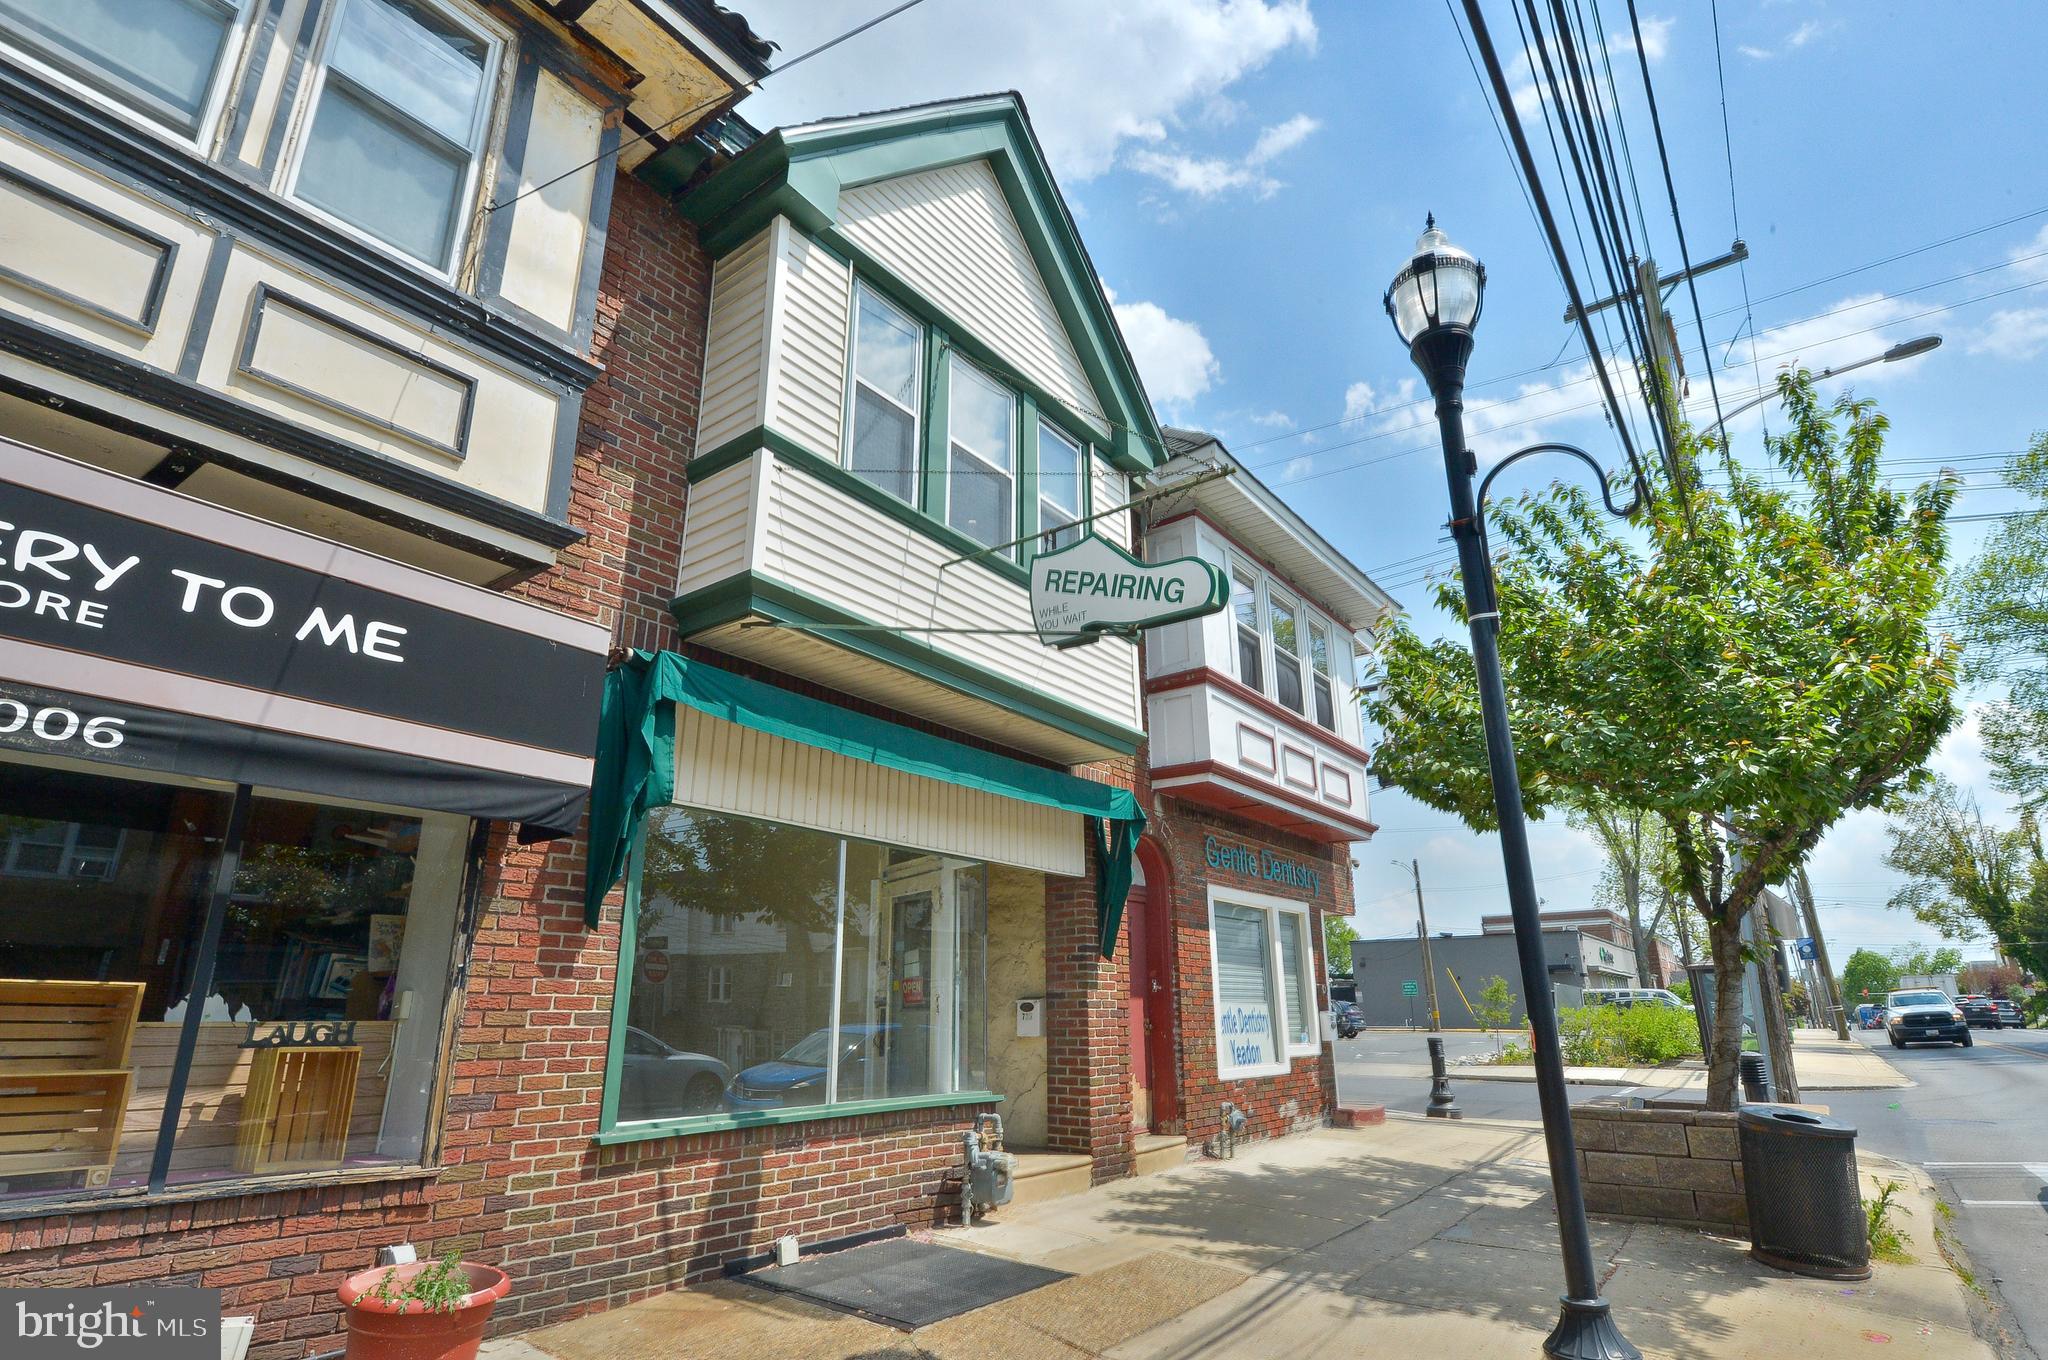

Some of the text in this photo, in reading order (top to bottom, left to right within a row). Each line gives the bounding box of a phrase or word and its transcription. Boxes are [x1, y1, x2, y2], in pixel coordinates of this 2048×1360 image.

[1044, 568, 1185, 604] REPAIRING
[171, 568, 275, 628] TO
[295, 606, 408, 663] ME
[1039, 602, 1069, 619] WHILE
[1039, 609, 1087, 632] YOU WAIT
[1205, 835, 1320, 897] Gentle Dentistry
[902, 980, 922, 993] OPEN
[241, 1021, 357, 1047] LAUGH
[1237, 1007, 1269, 1040] Dentistry
[1230, 1038, 1262, 1065] Yeadon
